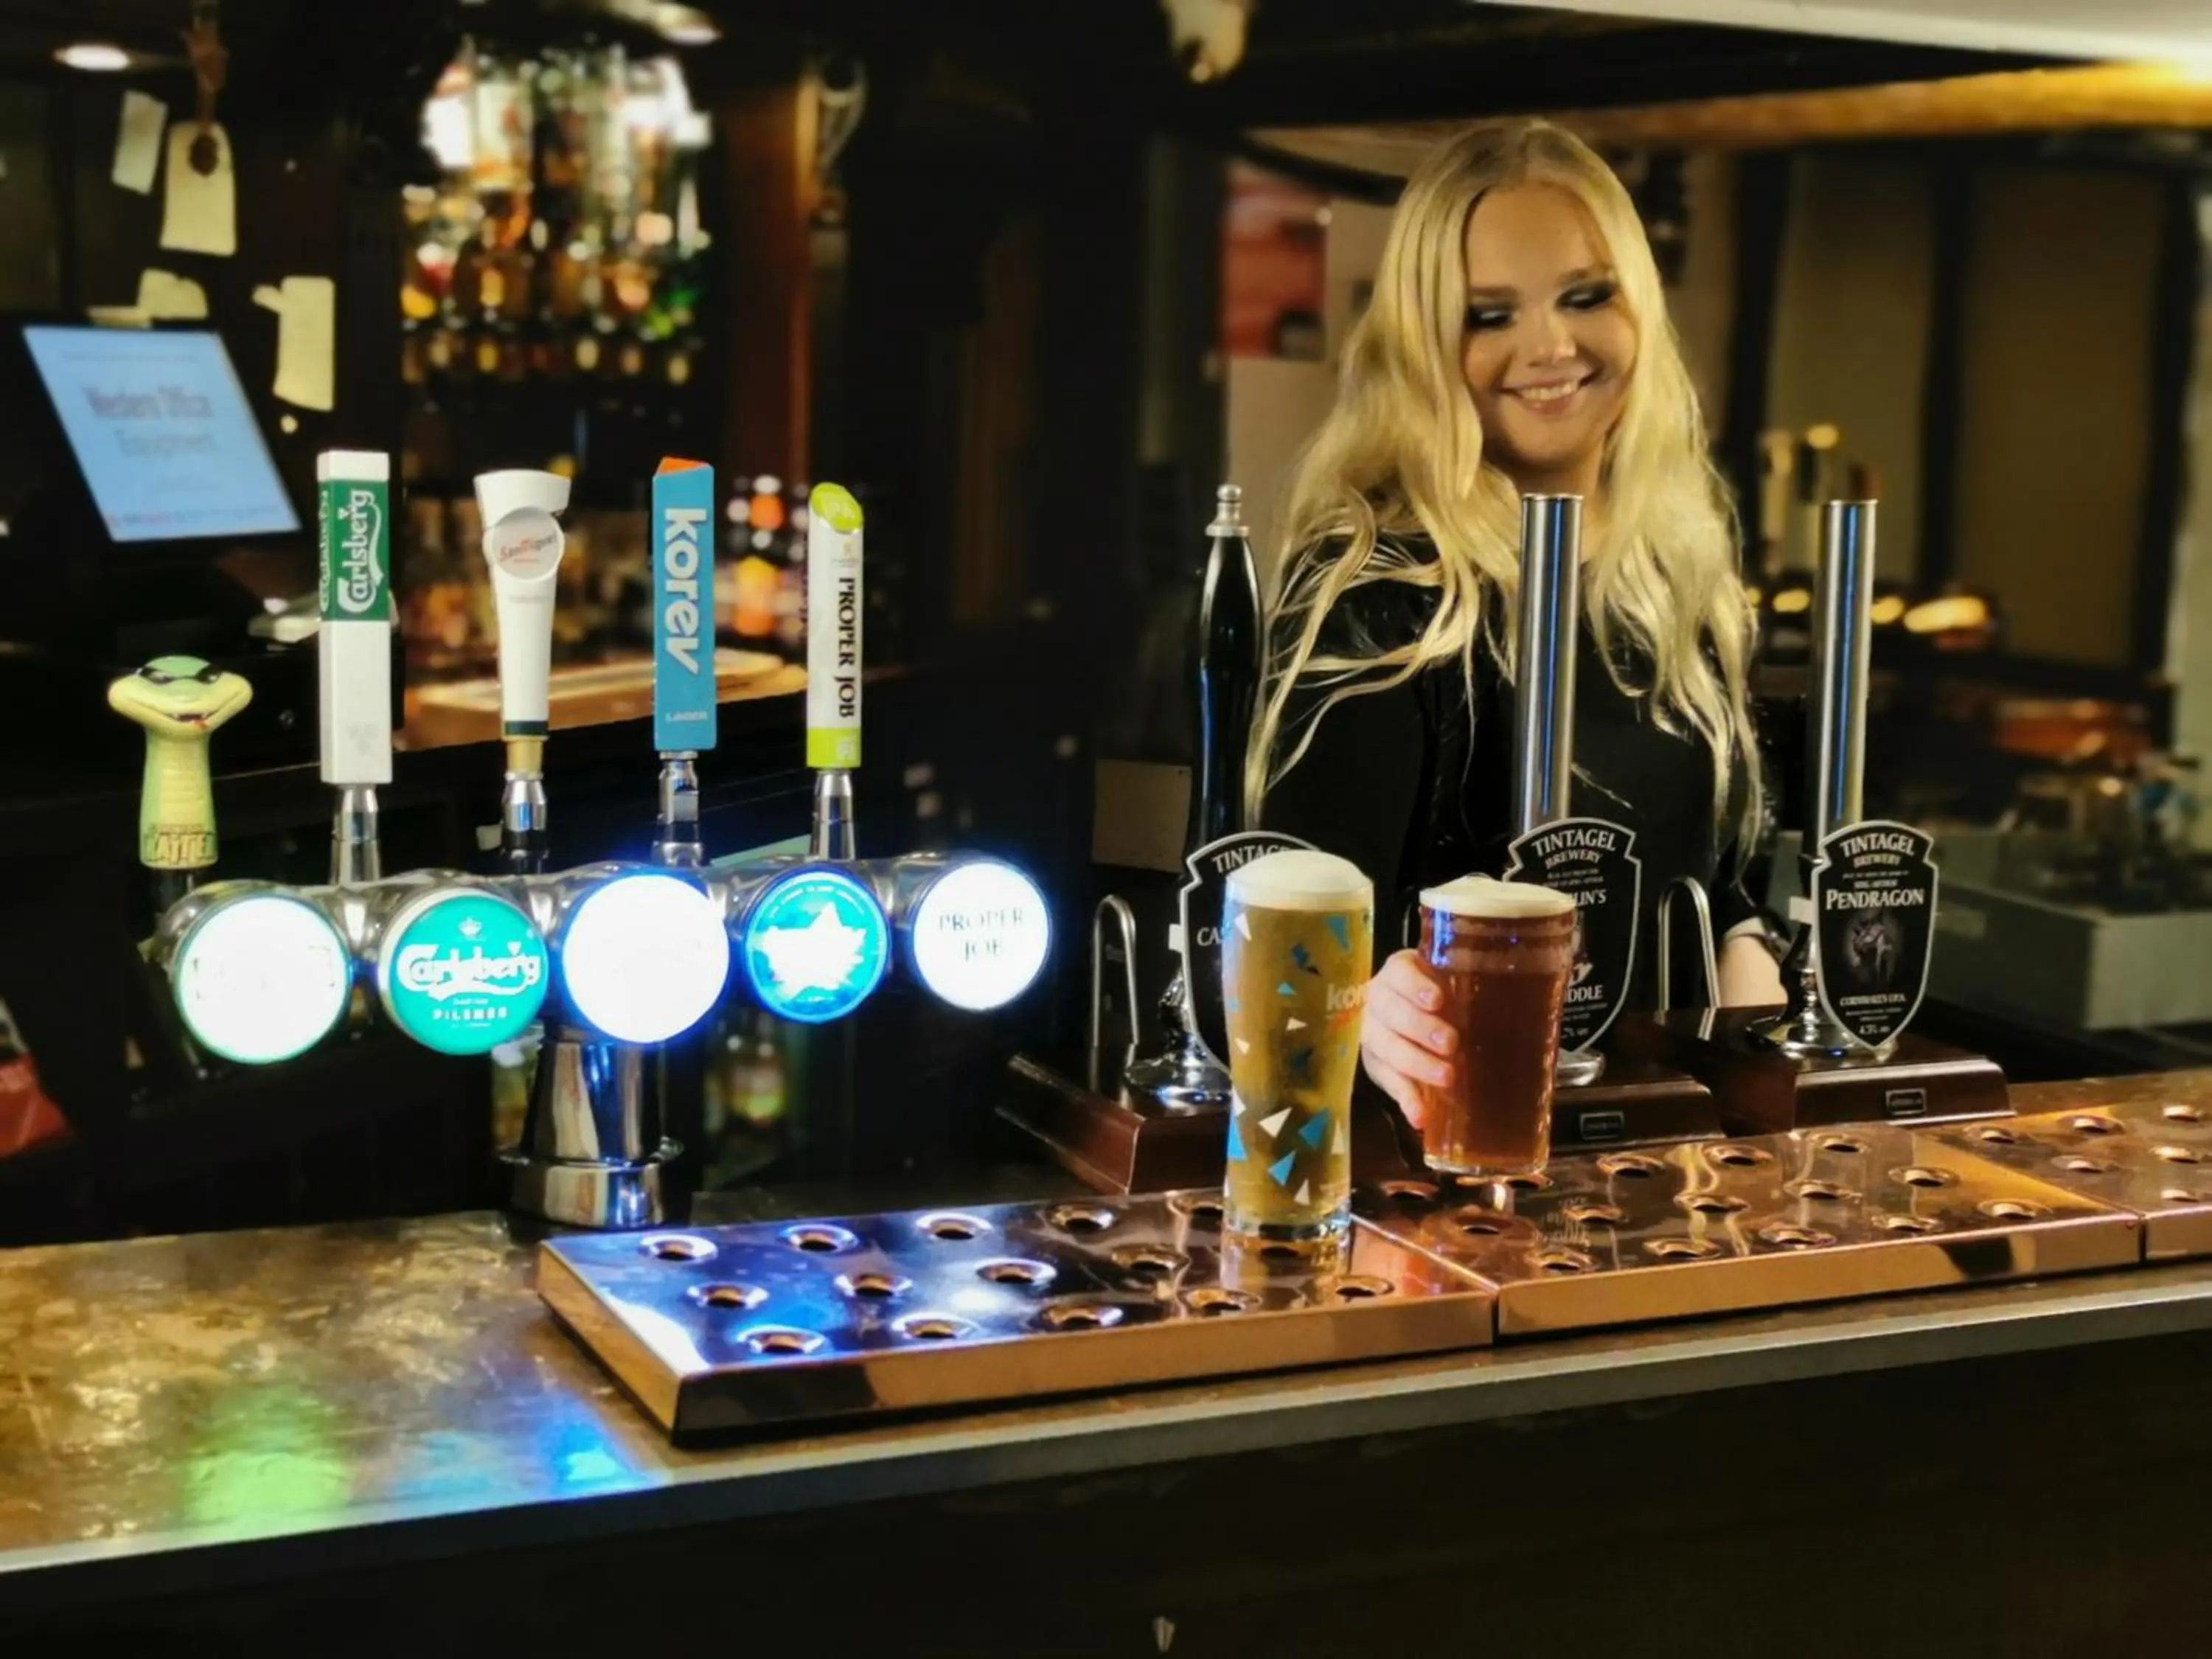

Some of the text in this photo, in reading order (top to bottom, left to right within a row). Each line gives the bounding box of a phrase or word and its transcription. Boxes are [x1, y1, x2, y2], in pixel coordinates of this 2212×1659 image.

[338, 490, 382, 613] Carlsberg
[665, 509, 707, 675] korev
[838, 577, 856, 667] PROPER
[835, 676, 855, 718] JOB
[1531, 829, 1616, 857] TINTAGEL
[1545, 849, 1603, 869] BREWERY
[1840, 833, 1916, 857] TINTAGEL
[1826, 888, 1925, 911] PENDRAGON
[397, 941, 540, 1001] Carlsberg
[1565, 984, 1604, 1003] DDLE
